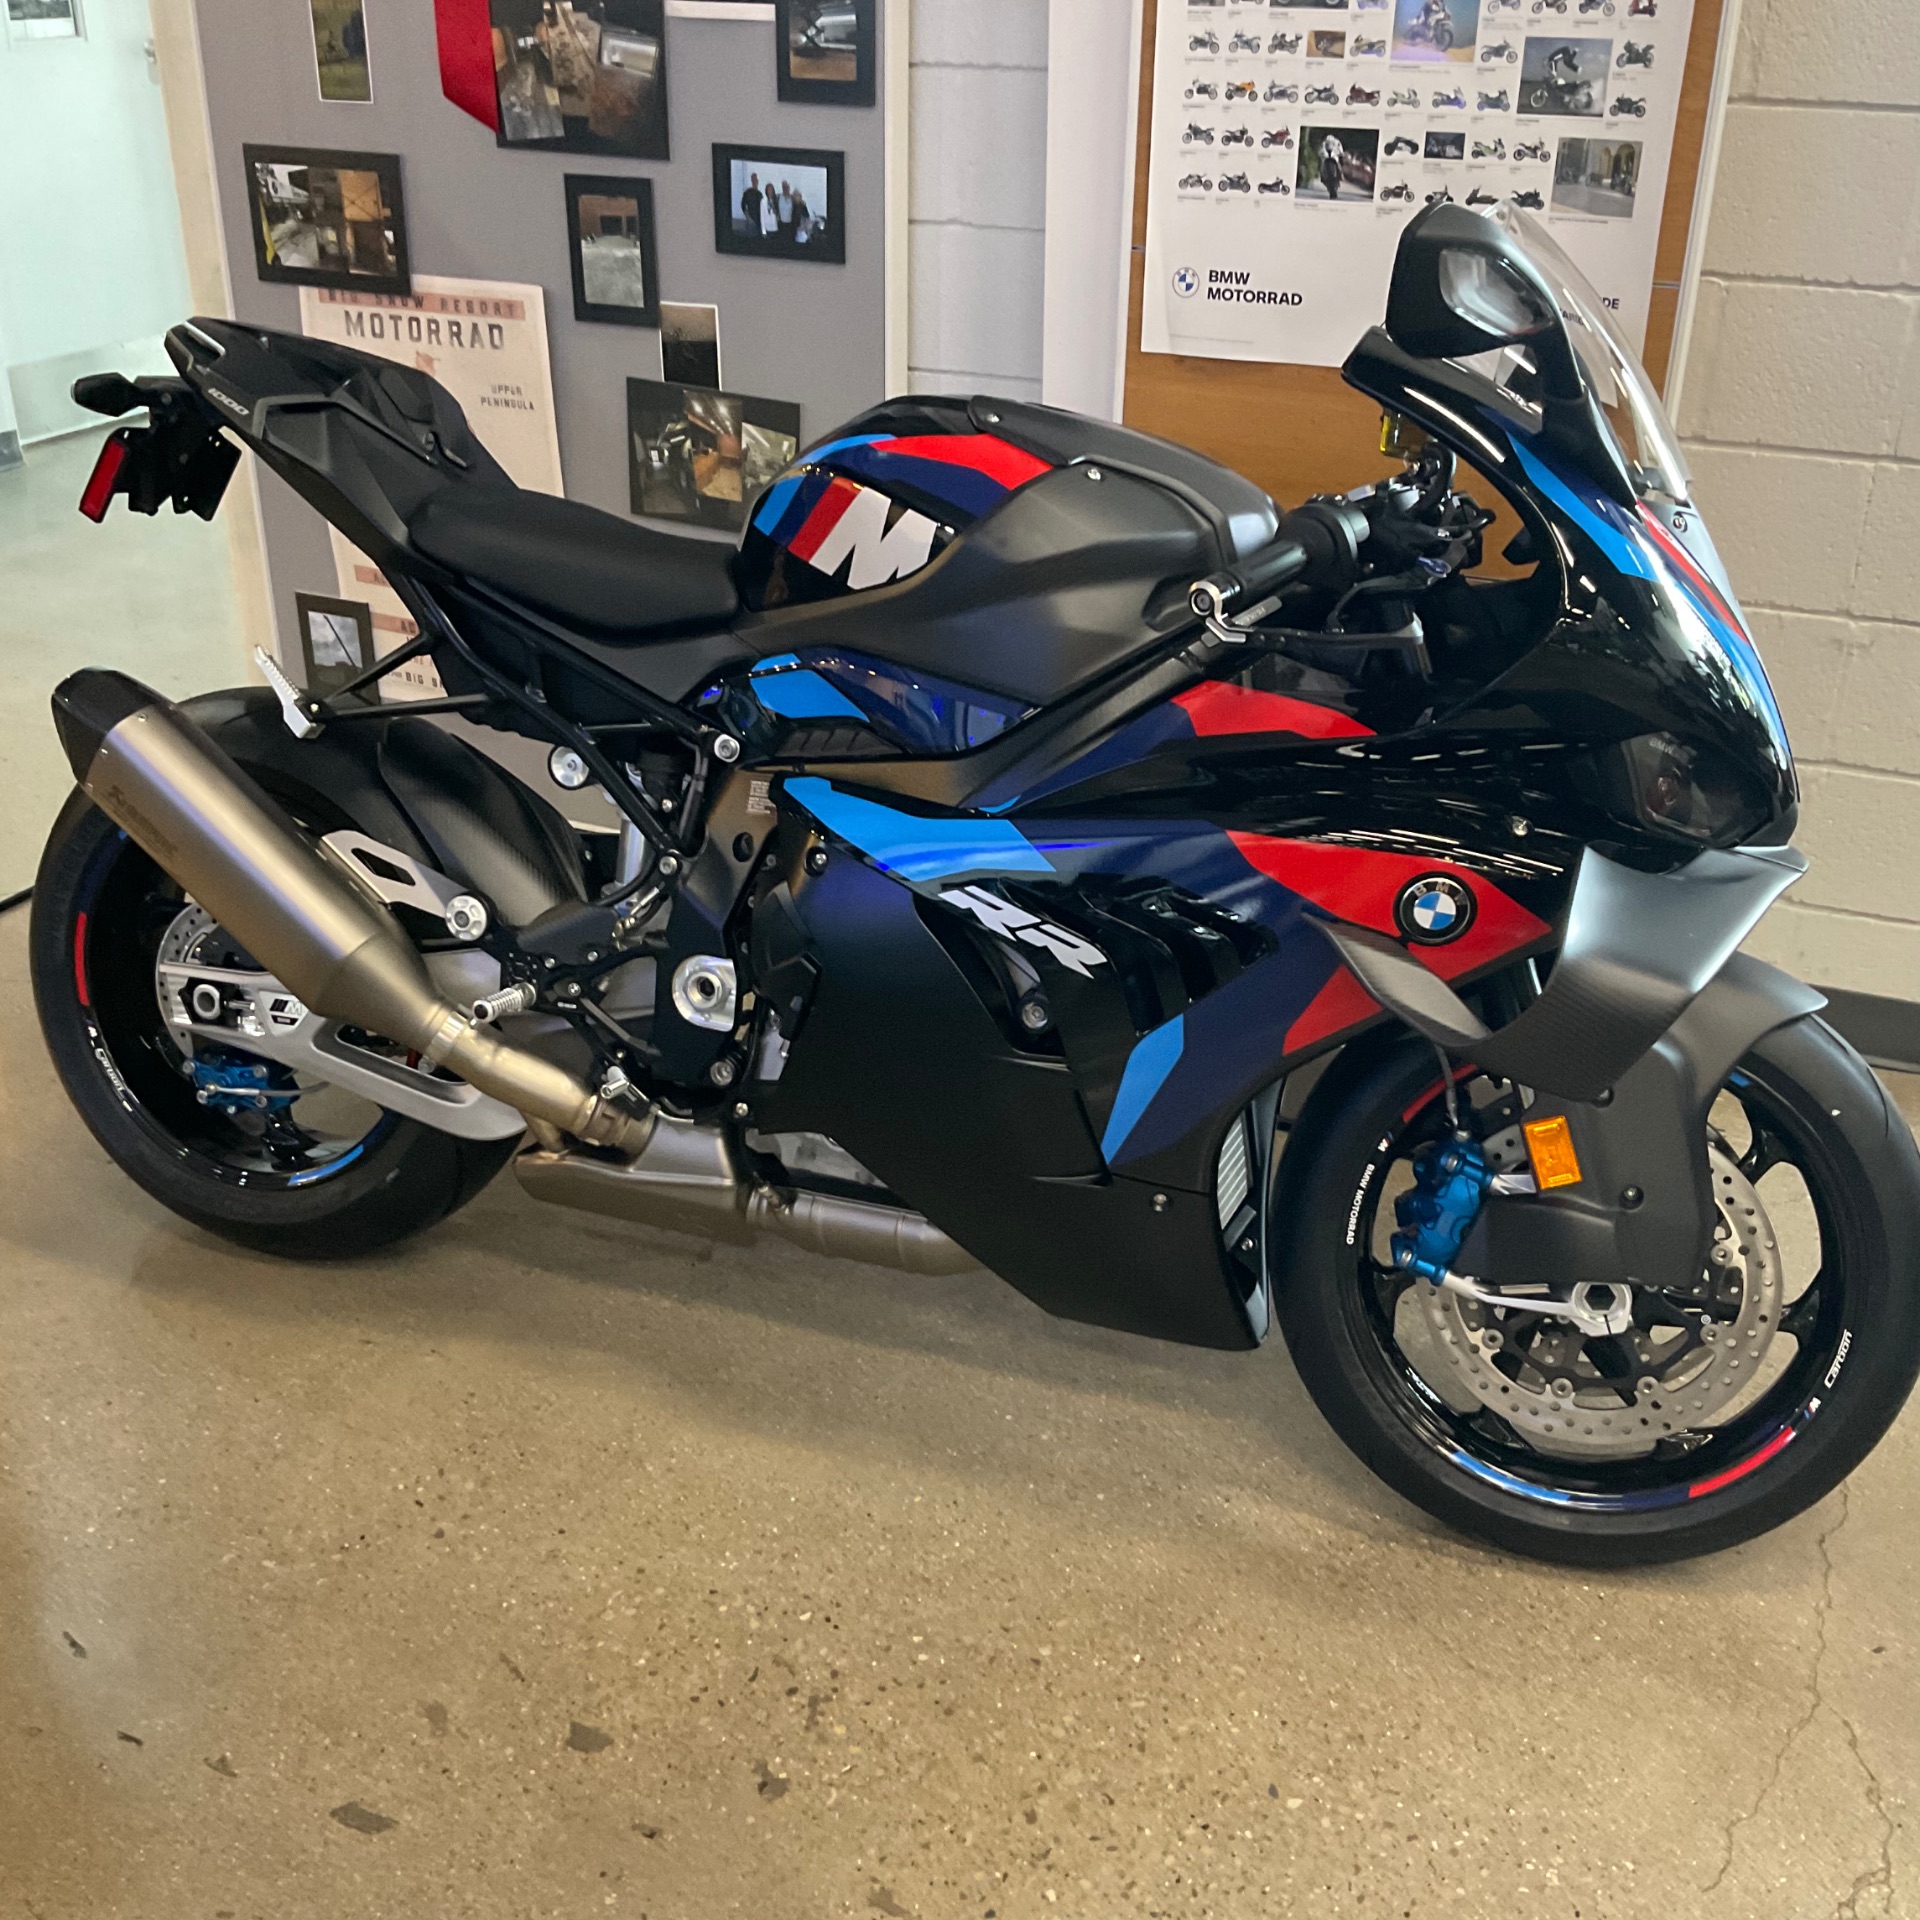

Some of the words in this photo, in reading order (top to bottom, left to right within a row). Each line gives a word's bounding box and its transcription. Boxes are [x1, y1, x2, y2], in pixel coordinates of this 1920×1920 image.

[1208, 270, 1250, 285] BMW
[440, 298, 516, 316] RESORT
[1207, 287, 1303, 306] MOTORRAD
[344, 310, 504, 350] MOTORRAD
[207, 387, 250, 416] 1000
[480, 396, 535, 411] PENINSULA
[1414, 880, 1468, 906] BMW
[1359, 1163, 1376, 1189] BMW
[1346, 1189, 1365, 1246] MOTORRAD
